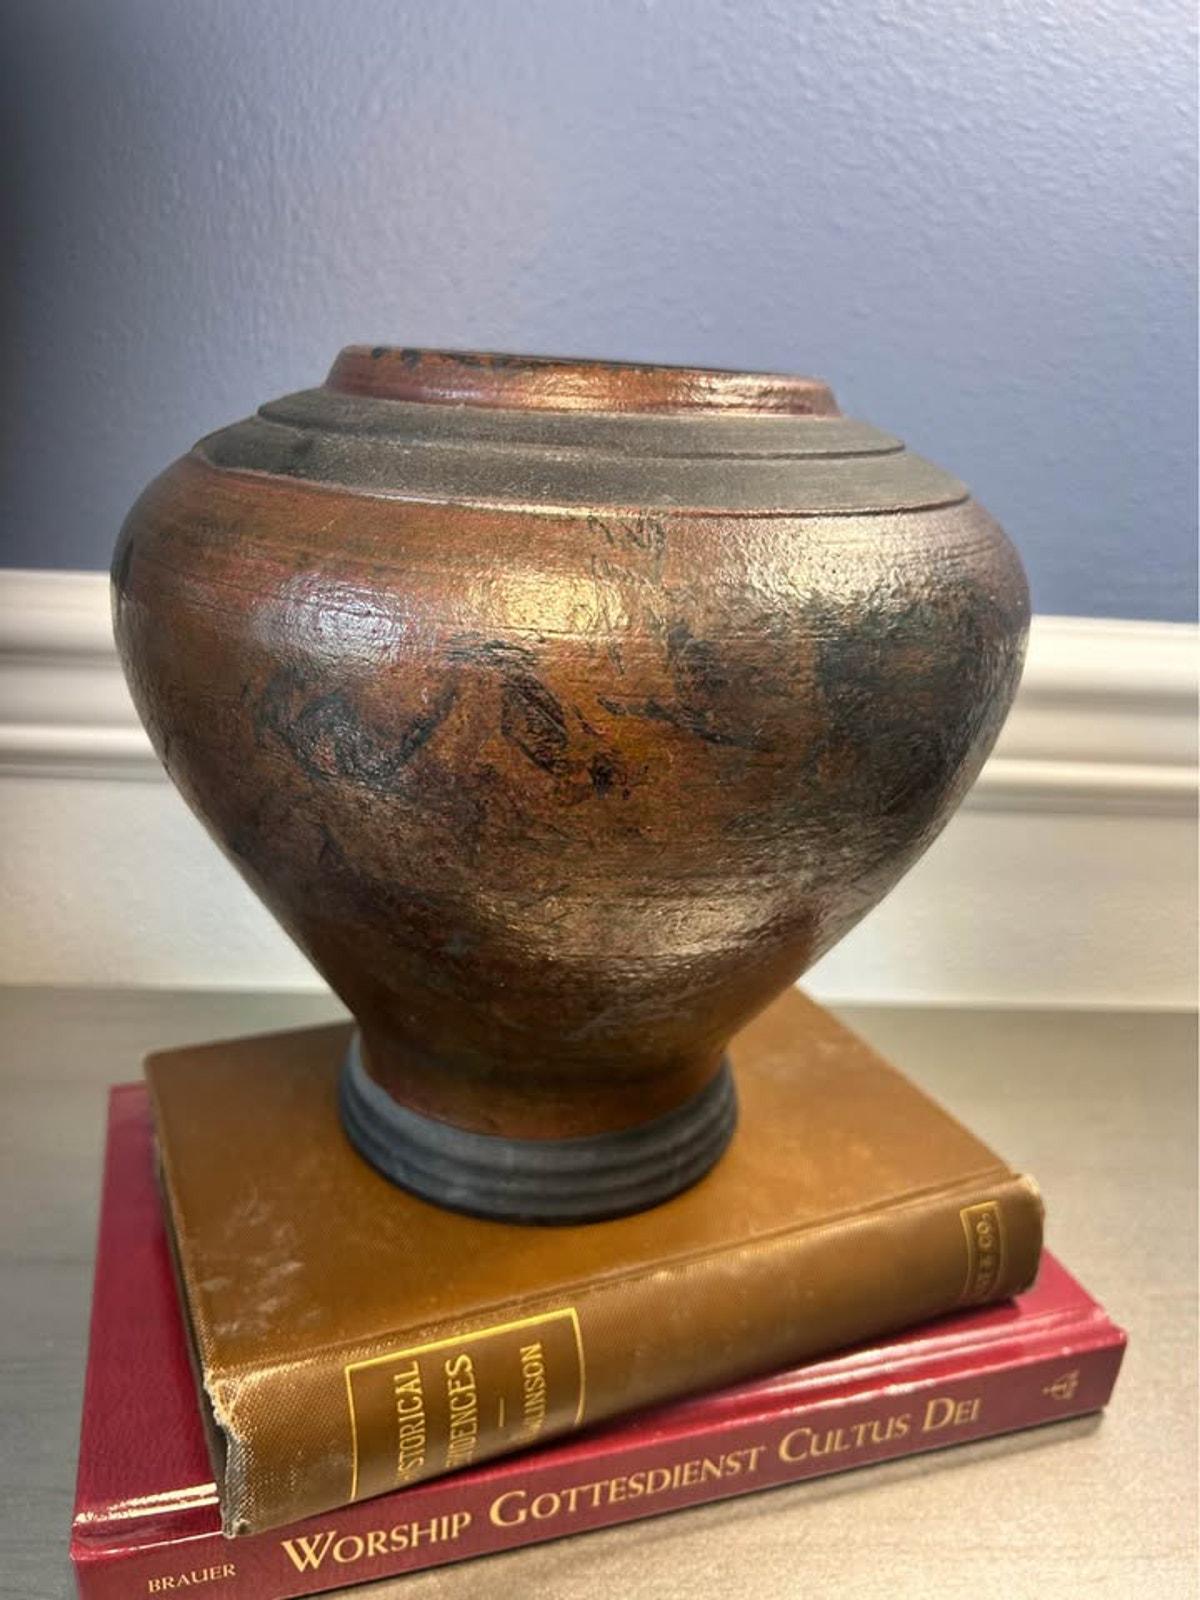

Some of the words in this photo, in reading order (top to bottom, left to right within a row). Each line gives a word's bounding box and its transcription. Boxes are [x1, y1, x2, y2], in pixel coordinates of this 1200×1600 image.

[393, 1361, 426, 1480] STORICAL
[281, 1512, 472, 1573] WORSHIP
[488, 1444, 767, 1527] GOTTESDIENST
[777, 1412, 913, 1463] CULTUS
[921, 1397, 982, 1433] DEI
[147, 1563, 237, 1594] BRAUER
